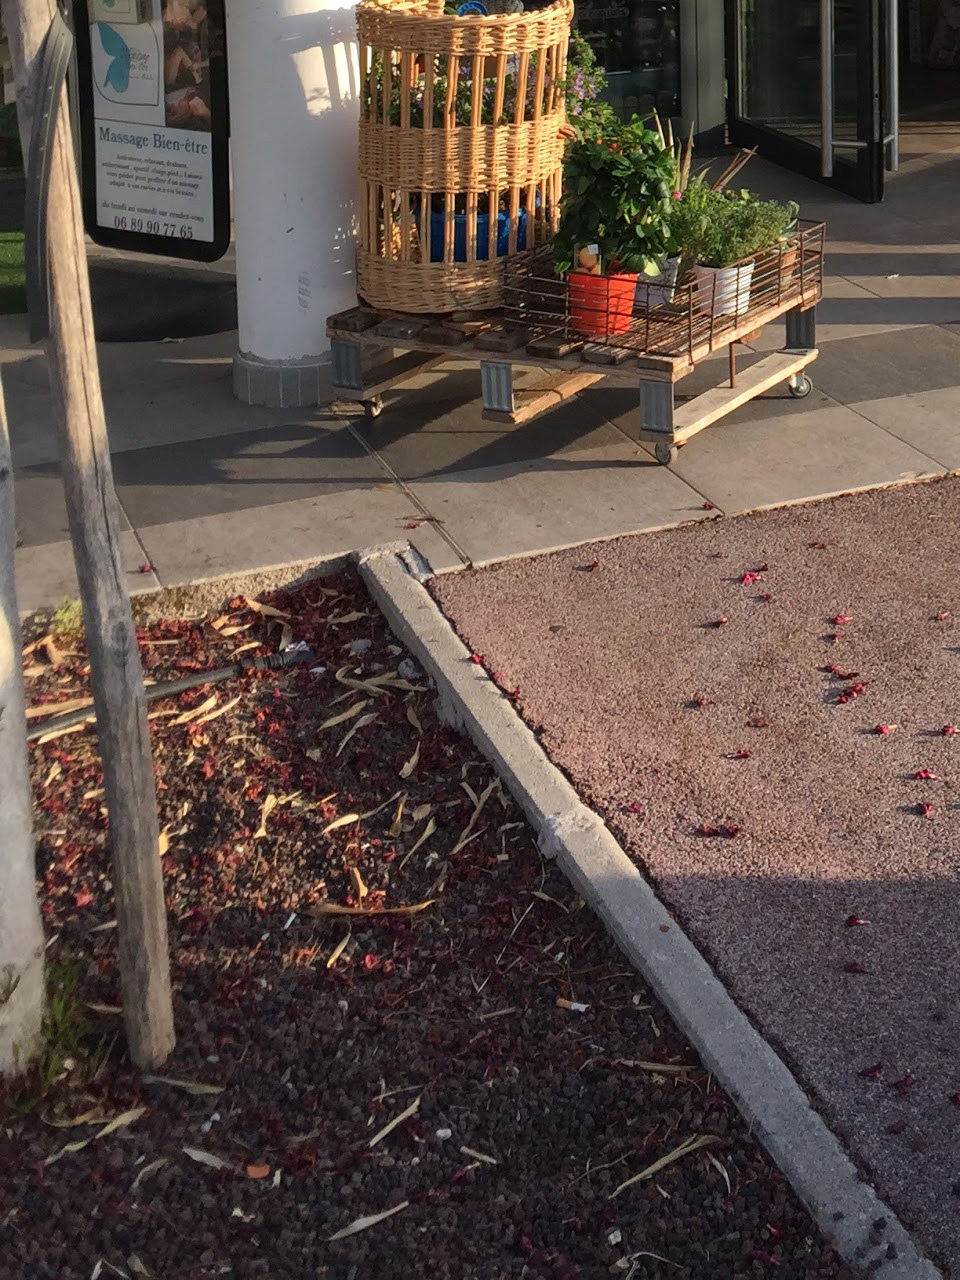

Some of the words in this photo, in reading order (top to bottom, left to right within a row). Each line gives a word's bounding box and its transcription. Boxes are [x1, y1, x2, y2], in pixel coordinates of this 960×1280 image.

[99, 126, 149, 149] Massage
[153, 133, 208, 155] Bien-être
[114, 215, 128, 229] 06
[130, 217, 143, 233] 89
[146, 220, 160, 234] 90
[163, 223, 176, 237] 77
[180, 225, 193, 240] 65
